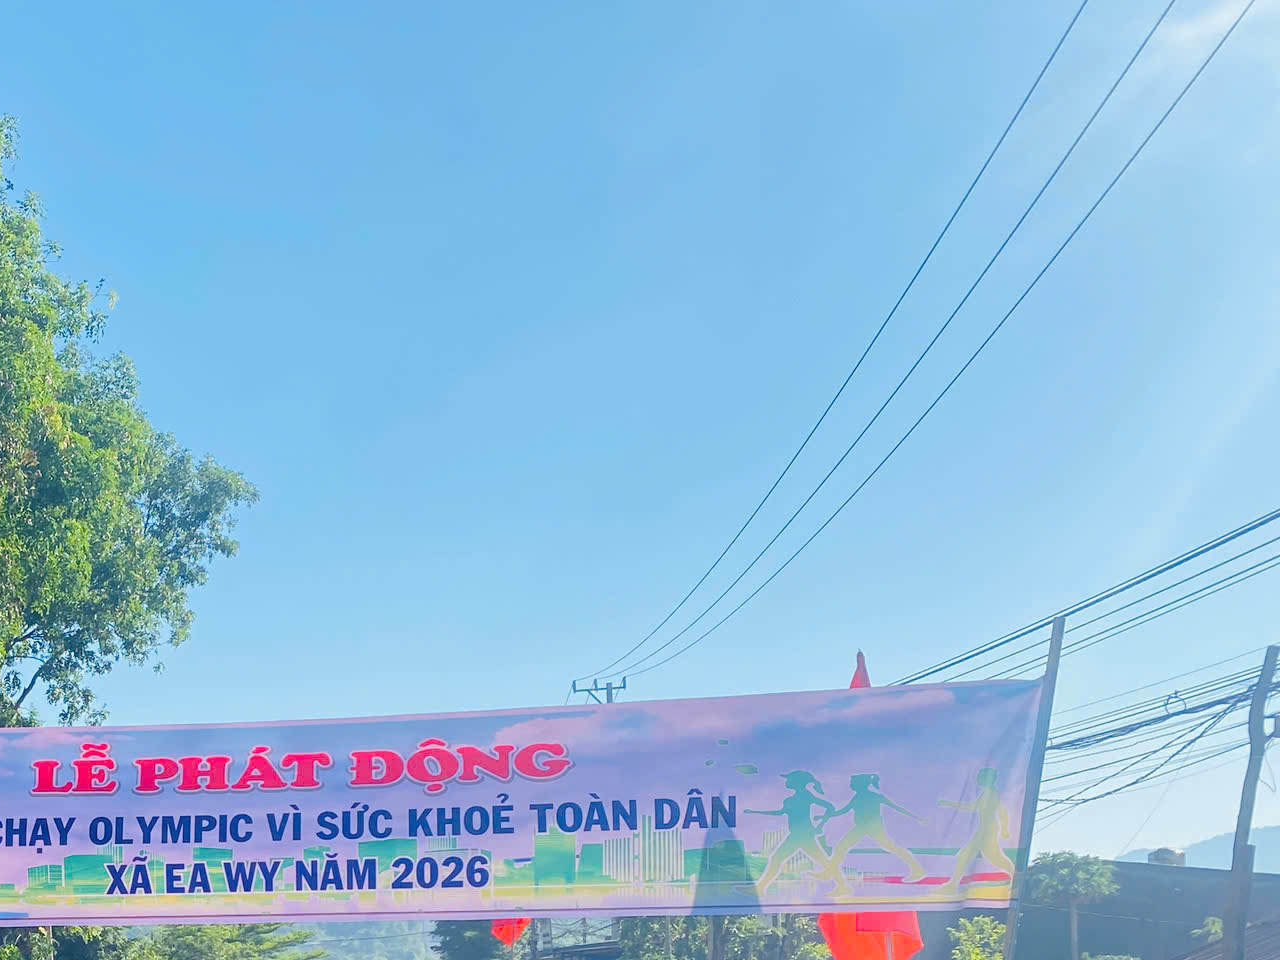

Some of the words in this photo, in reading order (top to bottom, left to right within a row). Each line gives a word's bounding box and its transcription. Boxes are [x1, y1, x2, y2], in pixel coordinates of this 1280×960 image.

[31, 743, 118, 793] LỄ
[134, 746, 331, 791] PHÁT
[350, 738, 570, 793] ĐỘNG
[89, 813, 254, 845] OLYMPIC
[266, 805, 302, 841] VÌ
[316, 802, 393, 840] SỨC
[408, 793, 515, 837] KHOẺ
[529, 792, 638, 834] TOÀN
[654, 788, 737, 830] DÂN
[106, 856, 153, 895] XÃ
[165, 863, 212, 894] EA
[223, 861, 282, 892] WY
[295, 852, 377, 891] NĂM
[391, 855, 490, 889] 2026
